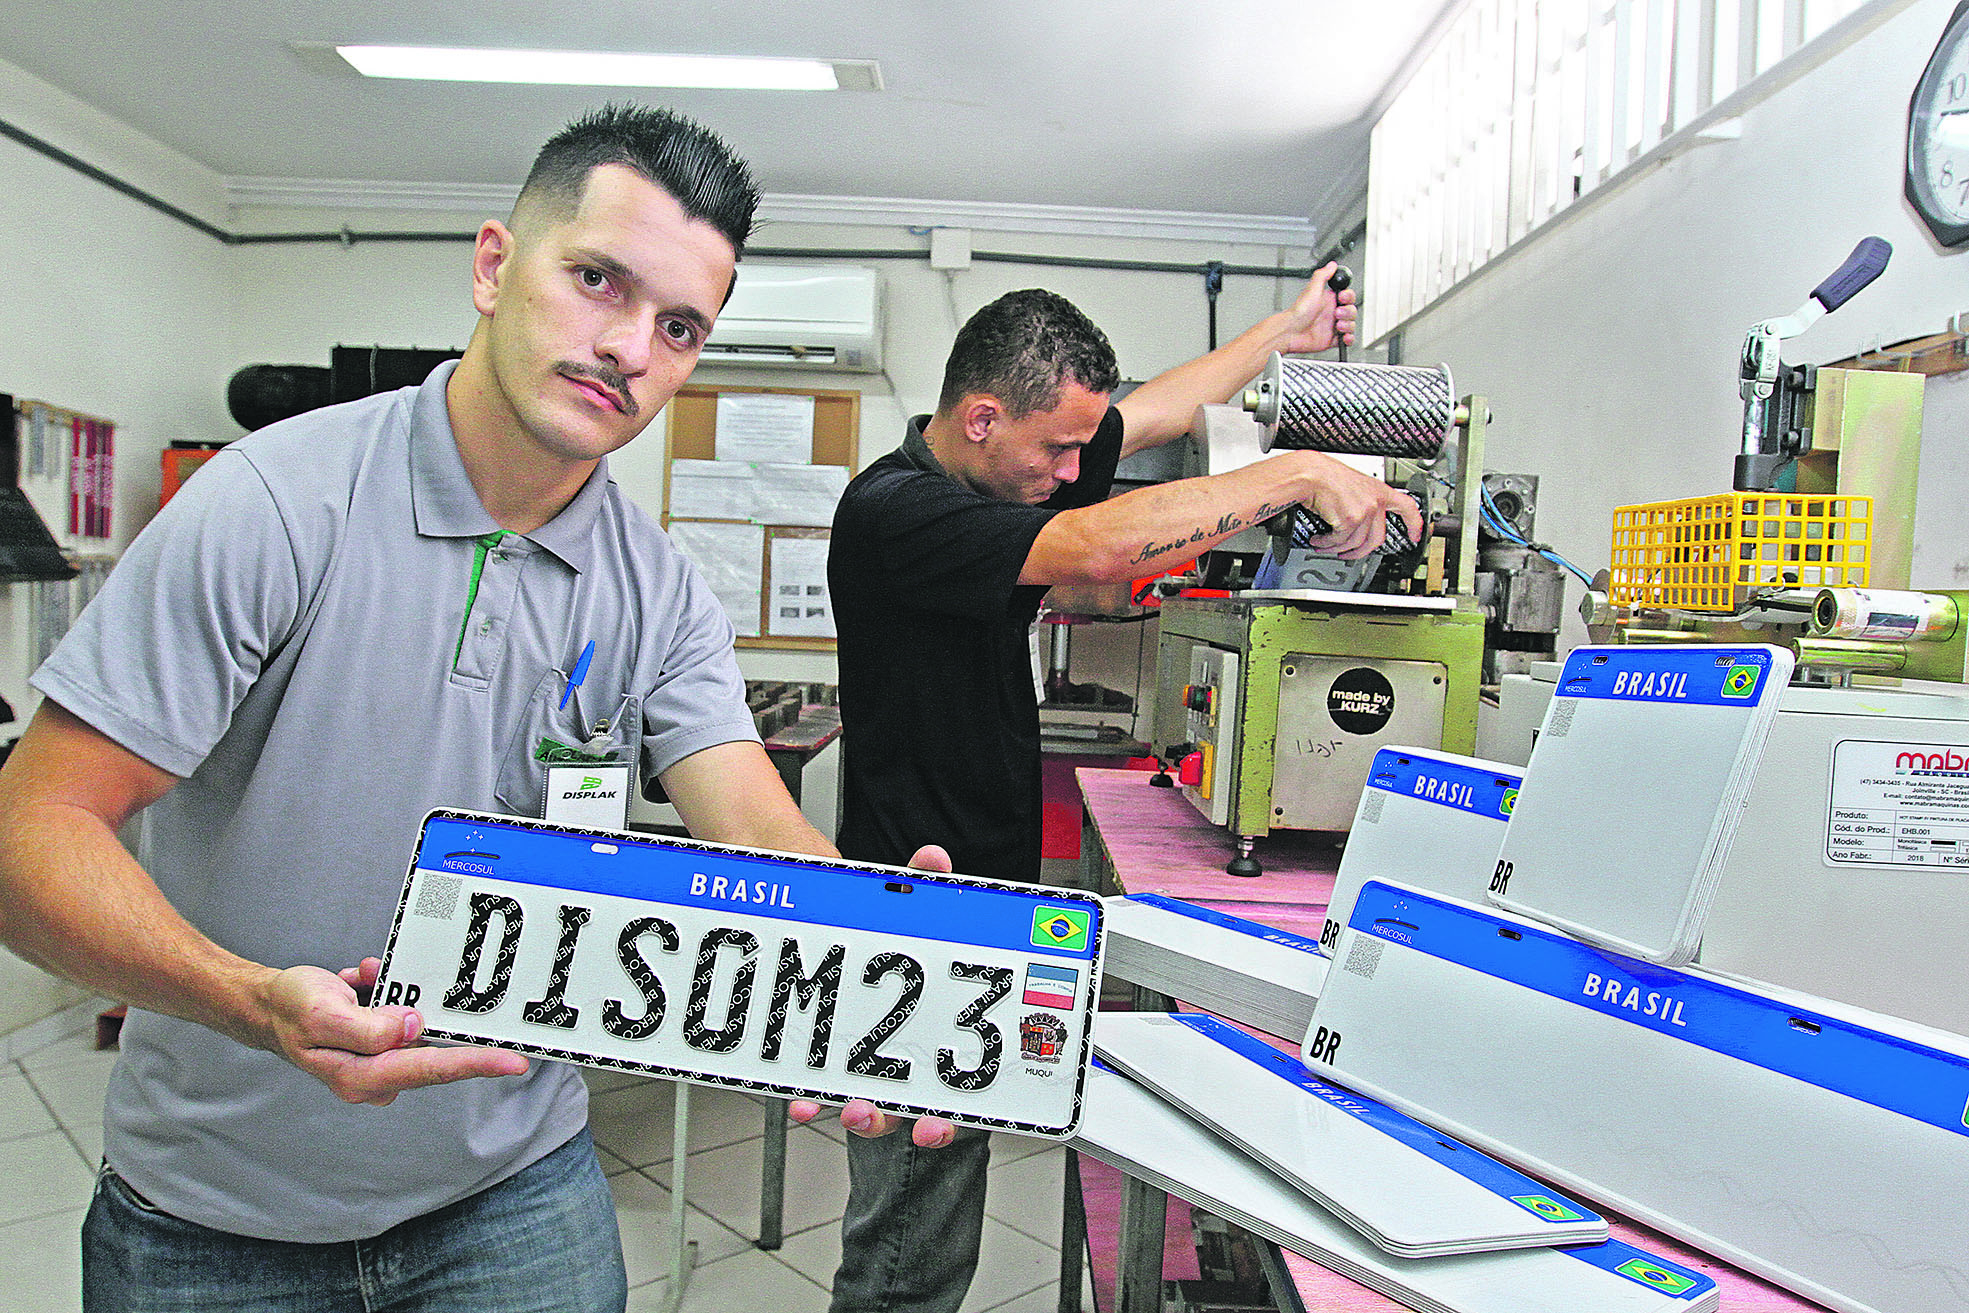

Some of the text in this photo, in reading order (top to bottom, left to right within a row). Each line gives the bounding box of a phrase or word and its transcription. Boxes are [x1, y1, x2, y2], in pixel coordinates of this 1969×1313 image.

[1941, 160, 1953, 188] 8
[1612, 671, 1688, 699] BRASIL
[1332, 690, 1391, 706] made by
[1341, 701, 1380, 715] KURZ
[562, 790, 617, 800] DISPLAK
[1413, 775, 1474, 809] BRASIL
[1835, 810, 1869, 820] Produto:
[1855, 825, 1866, 833] do
[1833, 837, 1865, 846] Modelo:
[1832, 850, 1849, 859] Ano
[1907, 854, 1925, 862] 2018
[442, 859, 495, 876] MERCOSUL
[1488, 859, 1514, 896] BR
[689, 872, 796, 909] BRASIL
[1320, 918, 1340, 950] BR
[1371, 923, 1413, 945] MERCOSUL
[1582, 972, 1688, 1028] BRASIL
[1310, 1025, 1341, 1066] BR
[1025, 1067, 1053, 1078] MUQUI
[1301, 1081, 1370, 1116] BRASIL
